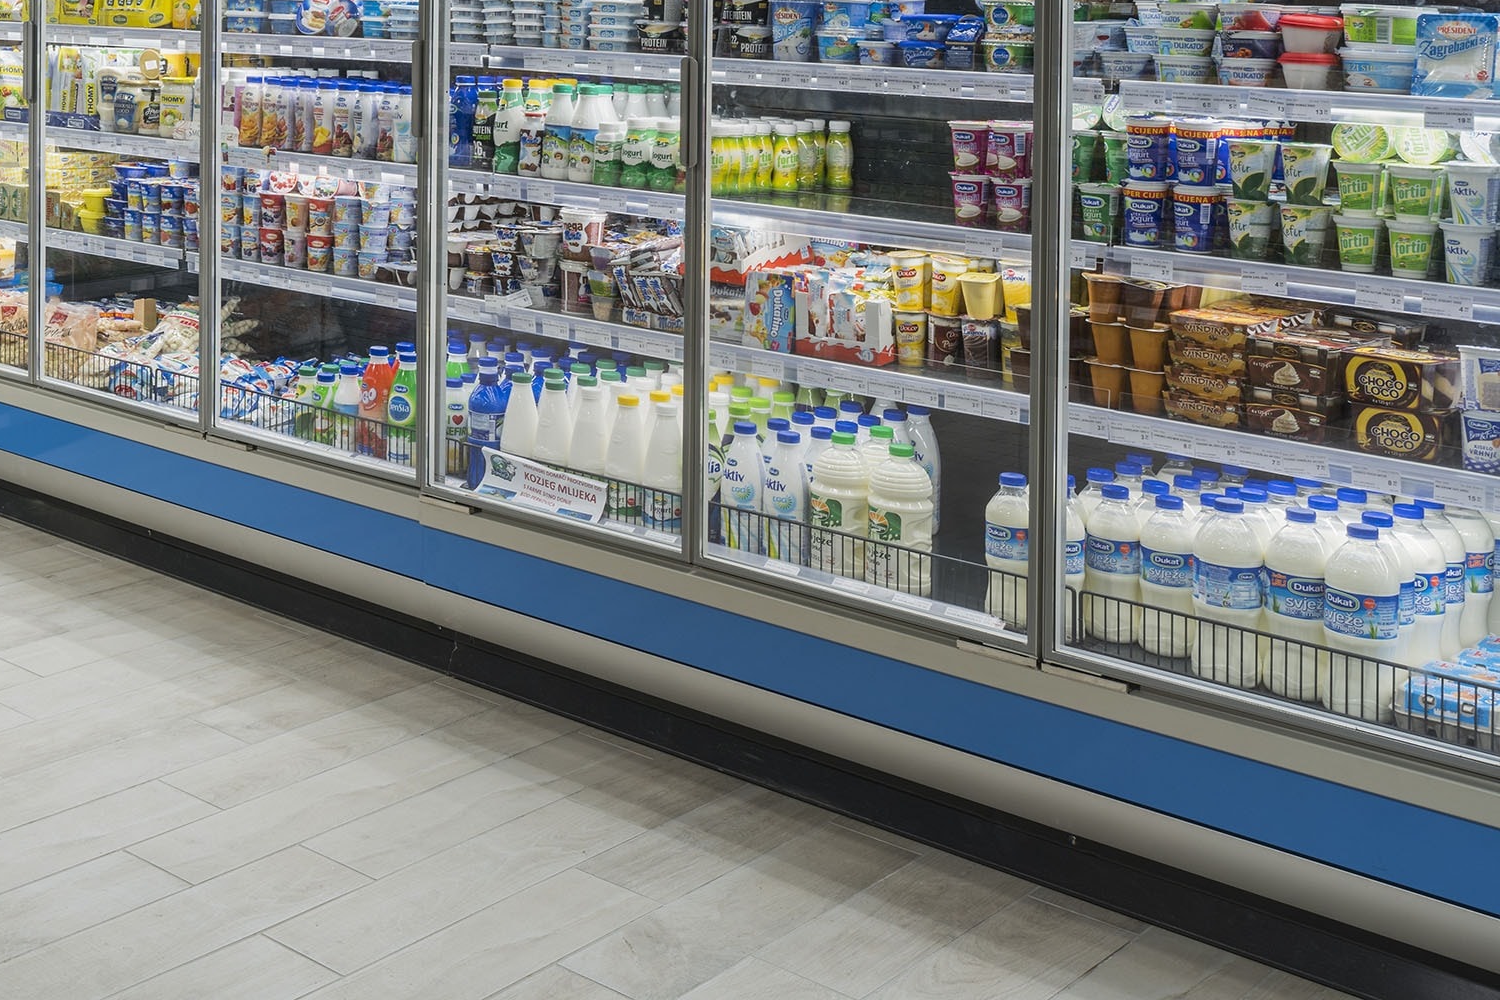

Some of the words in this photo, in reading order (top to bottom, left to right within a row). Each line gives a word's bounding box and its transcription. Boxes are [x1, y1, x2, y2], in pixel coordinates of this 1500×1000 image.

[641, 38, 667, 49] PROTEIN
[1173, 41, 1204, 50] DUKATOS
[1232, 72, 1264, 80] DUKATOS
[1134, 127, 1164, 135] CIJENA
[955, 184, 978, 193] Dukat
[996, 186, 1018, 196] Dukat
[1131, 202, 1156, 211] Dukat
[771, 288, 783, 338] Dukatino
[1184, 324, 1230, 337] VINDINO
[1183, 349, 1230, 364] VINDINO
[1179, 375, 1226, 391] VINDINO
[1358, 374, 1404, 391] CHOCO
[1365, 385, 1400, 400] LOCO
[1370, 426, 1421, 442] CHOCO
[1375, 437, 1414, 451] LOCO
[524, 472, 556, 491] KOZJEG
[557, 484, 597, 504] MLIJEKA
[987, 527, 1008, 539] Dukat
[1153, 555, 1180, 566] Dukat
[1293, 582, 1324, 594] Dukat
[1326, 593, 1355, 609] Dukat
